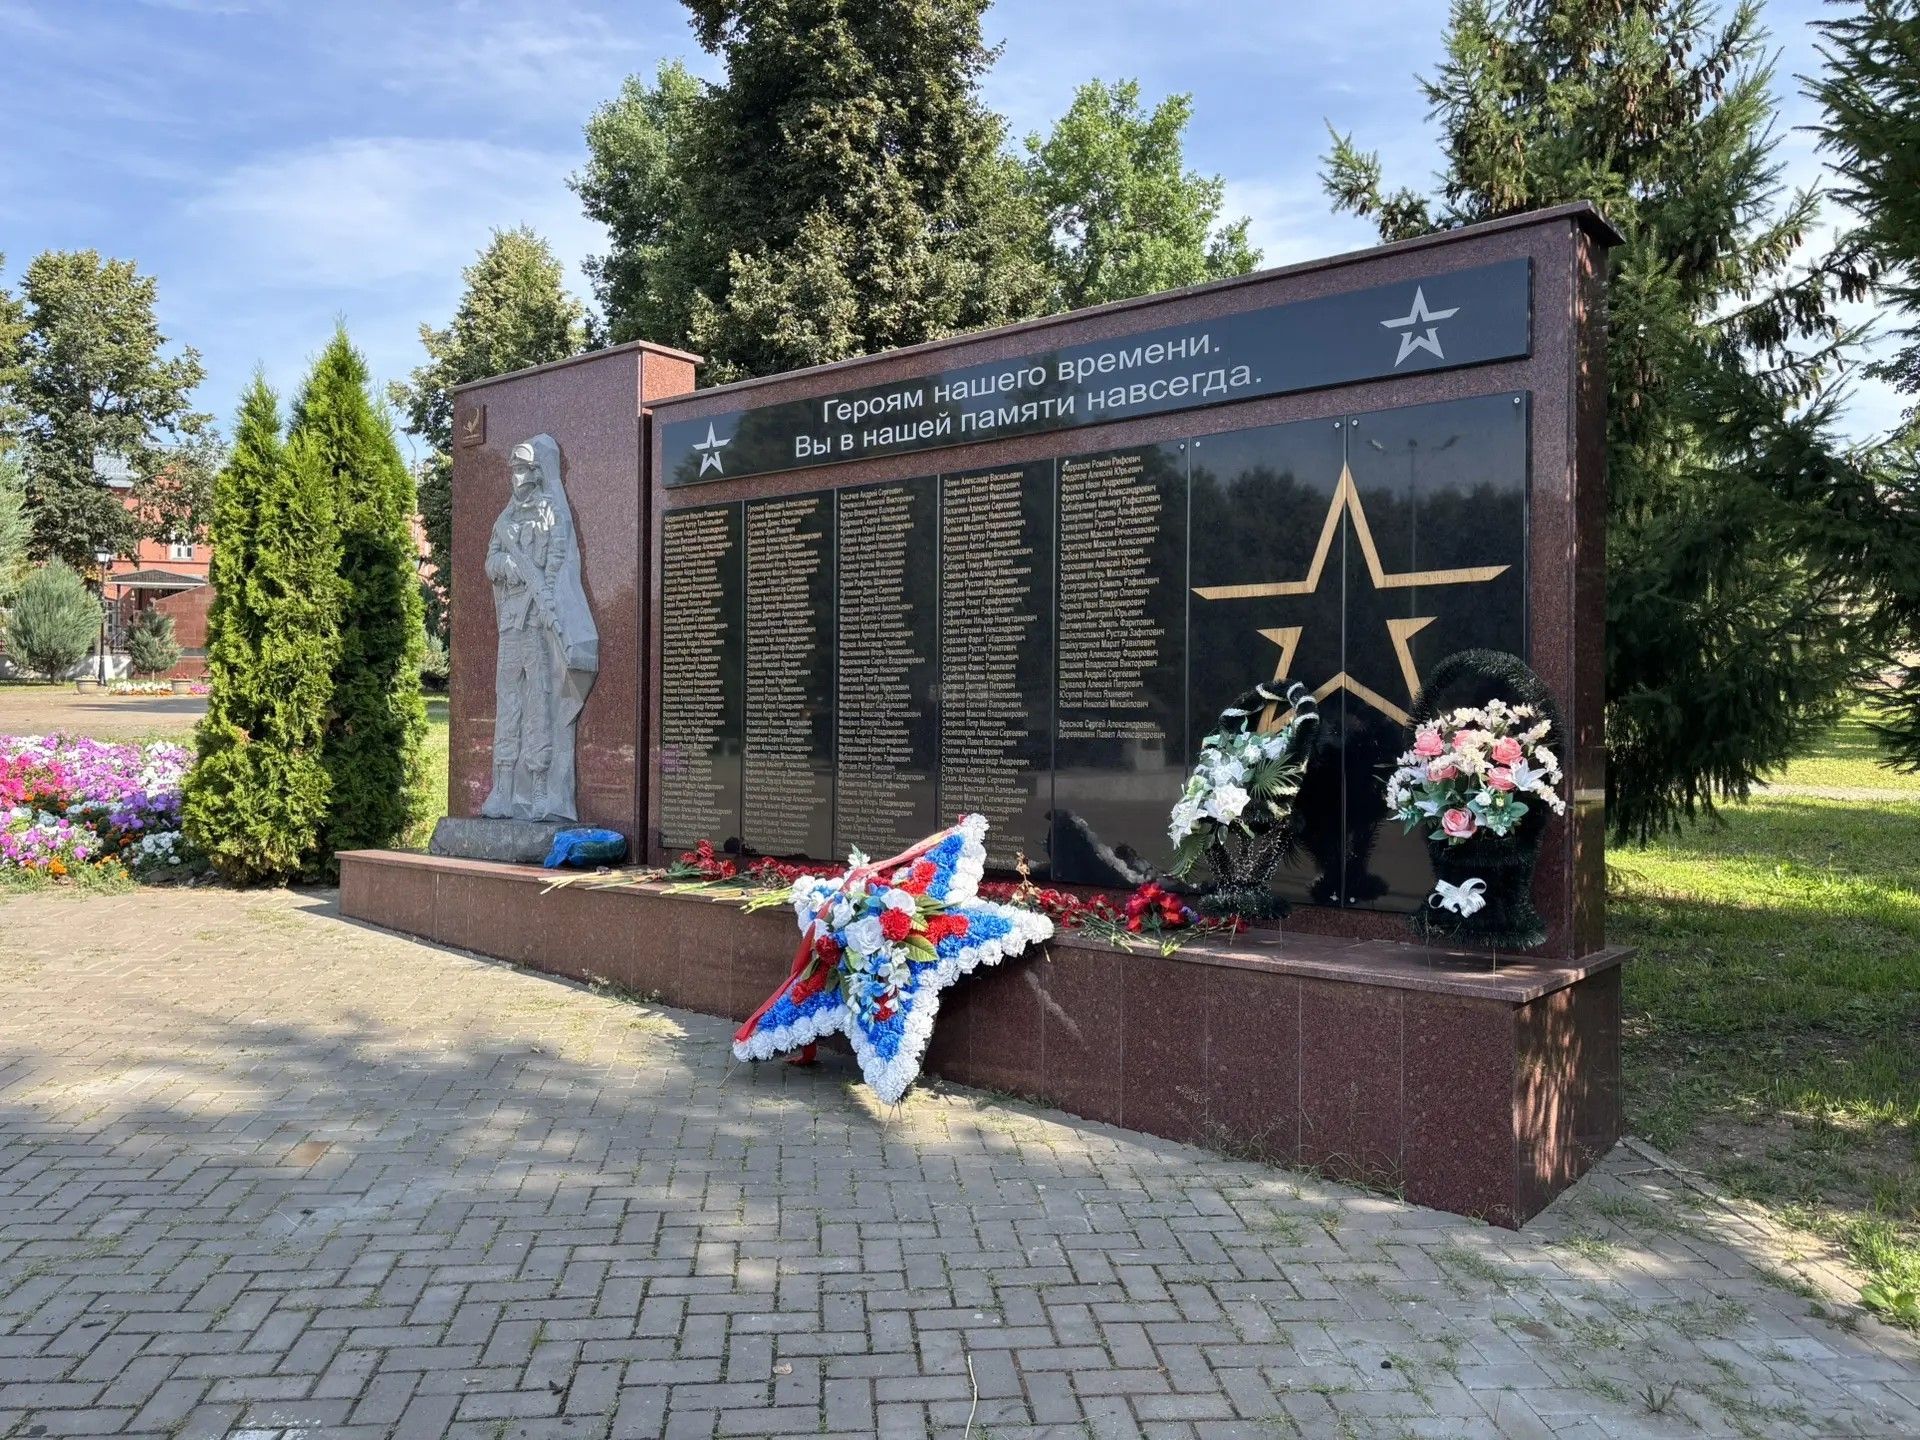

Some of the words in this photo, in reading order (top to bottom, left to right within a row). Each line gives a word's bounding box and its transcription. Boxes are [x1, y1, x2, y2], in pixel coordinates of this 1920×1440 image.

[795, 435, 831, 458] Вы
[840, 434, 855, 451] в
[863, 411, 951, 447] нашей
[960, 395, 1075, 432] памяти
[1087, 364, 1262, 411] навсегда.
[823, 389, 923, 424] Героям
[934, 366, 1047, 403] нашего
[1058, 334, 1220, 384] времени.
